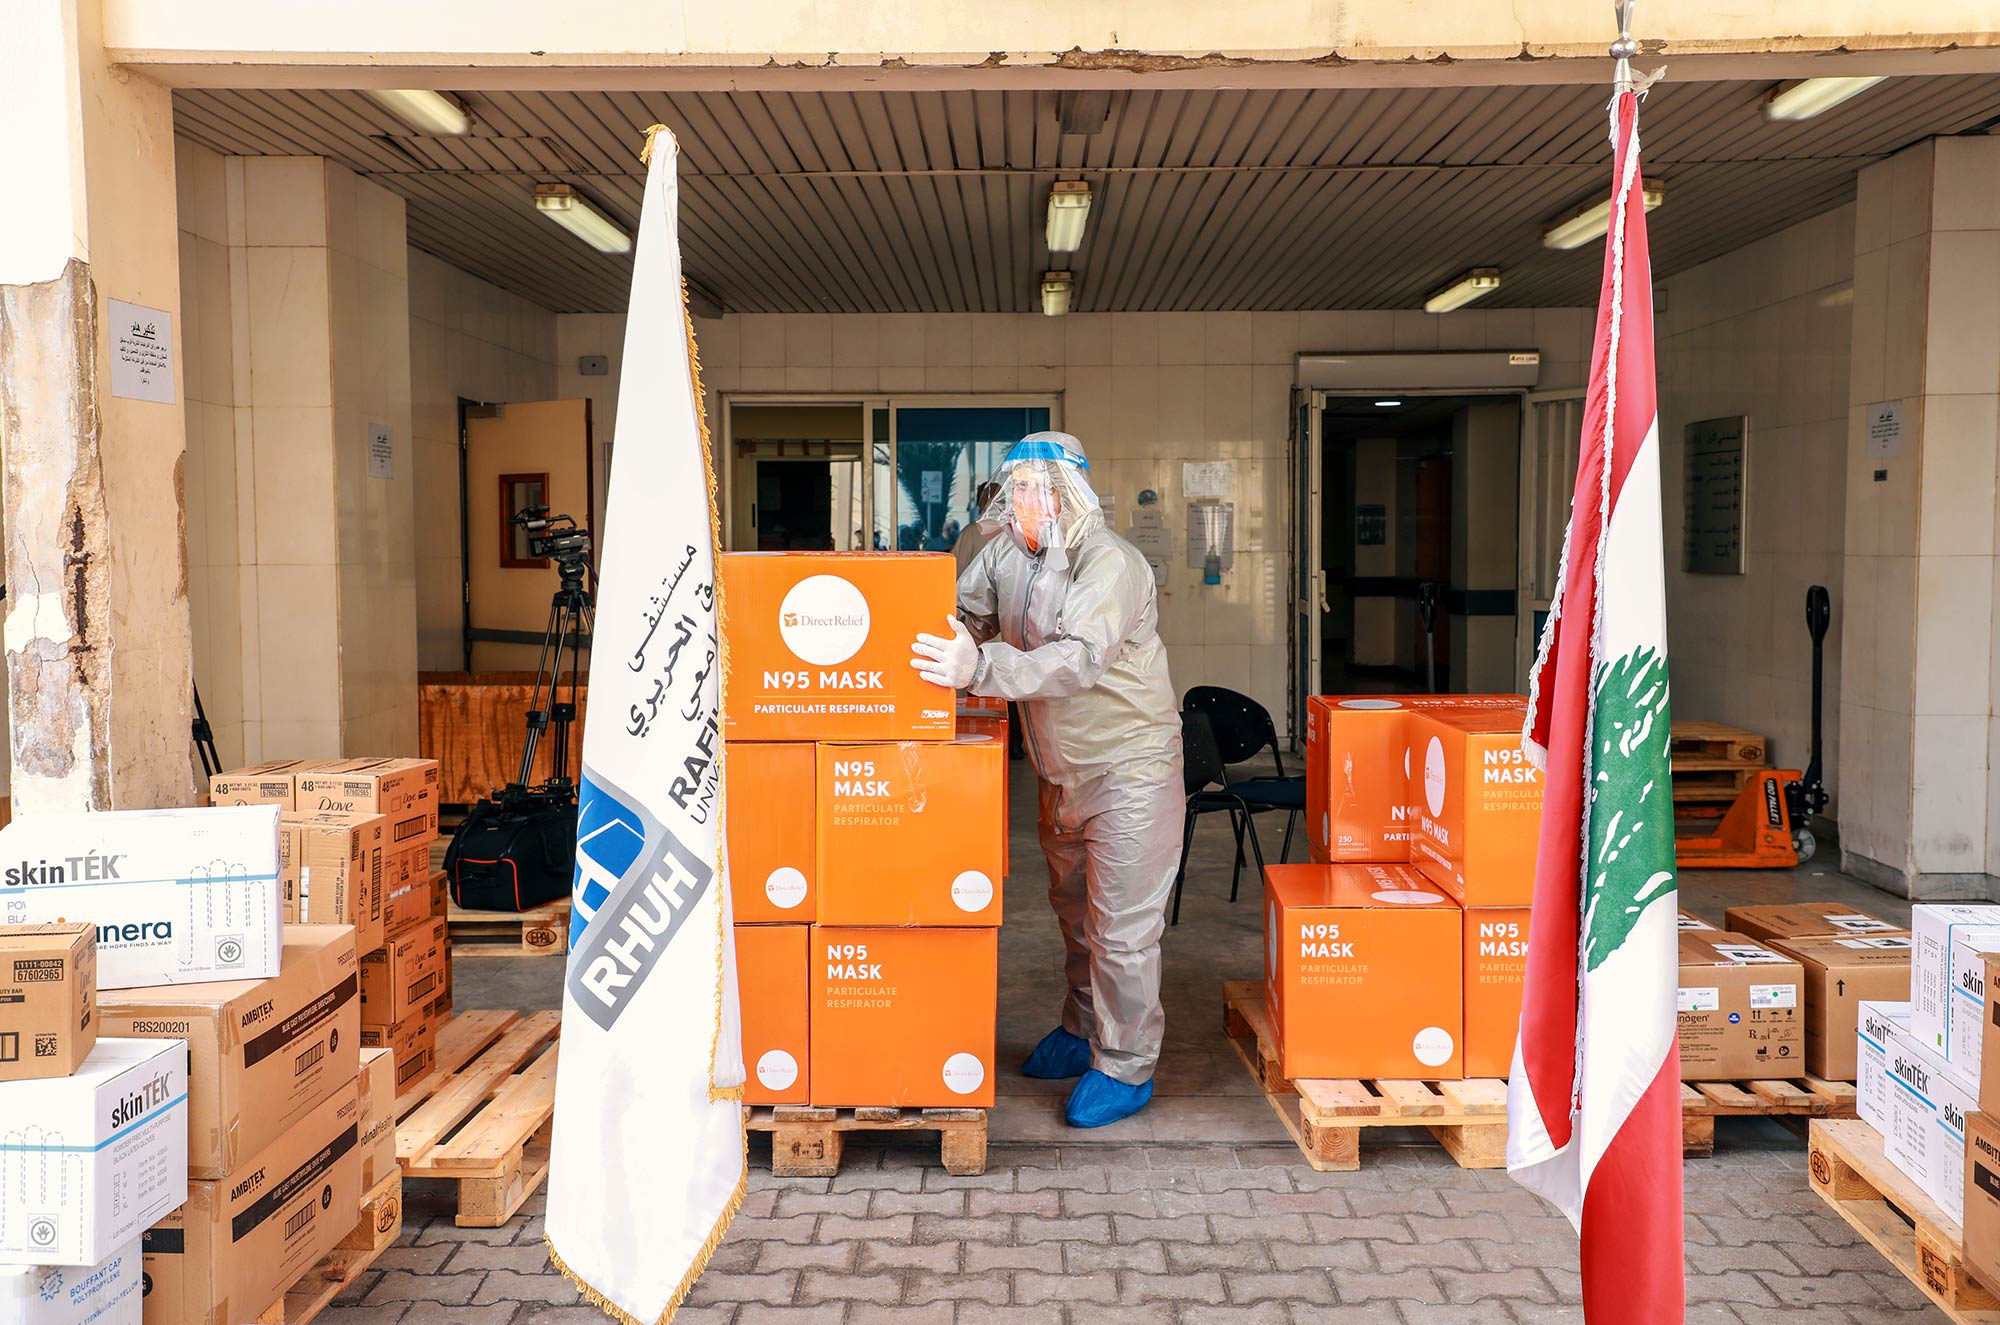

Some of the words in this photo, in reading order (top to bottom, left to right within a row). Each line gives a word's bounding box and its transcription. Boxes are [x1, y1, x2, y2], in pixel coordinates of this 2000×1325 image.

[628, 545, 697, 672] مستشفى
[626, 613, 697, 738] الحريري
[763, 671, 810, 689] N95
[819, 671, 883, 689] MASK
[754, 704, 827, 714] PARTICULATE
[829, 704, 896, 714] RESPIRATOR
[668, 706, 718, 810] RAFI
[1484, 750, 1522, 765] N95
[834, 761, 875, 777] N95
[1484, 768, 1537, 783] MASK
[215, 783, 228, 794] 48
[301, 781, 314, 792] 48
[834, 781, 890, 797] MASK
[1483, 790, 1544, 799] PARTICULAT
[318, 796, 354, 812] Dove
[402, 792, 416, 804] Dove
[834, 804, 905, 813] PARTICULATE
[1483, 802, 1542, 811] RESPIRATO
[834, 816, 900, 826] RESPIRATOR
[1338, 835, 1352, 843] 250
[1421, 815, 1433, 837] N95
[1433, 821, 1449, 847] MASK
[5, 849, 120, 886] skinTÉK
[531, 932, 550, 944] EPAL
[580, 851, 698, 1009] RHUH
[1300, 924, 1340, 940] N95
[1479, 923, 1519, 938] N95
[827, 945, 868, 960] N95
[1300, 942, 1355, 958] MASK
[15, 960, 62, 968] 11111-00842
[827, 964, 882, 980] MASK
[1300, 964, 1369, 973] PARTICULATE
[17, 969, 60, 981] 67602965
[1300, 976, 1364, 985] RESPIRATOR
[1962, 968, 1983, 996] skin
[827, 987, 897, 996] PARTICULATE
[827, 999, 892, 1008] RESPIRATOR
[242, 1000, 274, 1028] AMBITEX
[132, 1021, 190, 1033] PBS200201
[1894, 1055, 1928, 1095] skinTÉK
[112, 1071, 170, 1128] skinTÉK
[1944, 1102, 1964, 1132] skin
[1975, 1136, 2000, 1161] AMBIT
[231, 1168, 265, 1202] AMBITEX
[70, 1266, 107, 1298] BOUFFANT
[108, 1257, 122, 1272] CAP
[72, 1270, 120, 1306] POLYPROPYLENE
